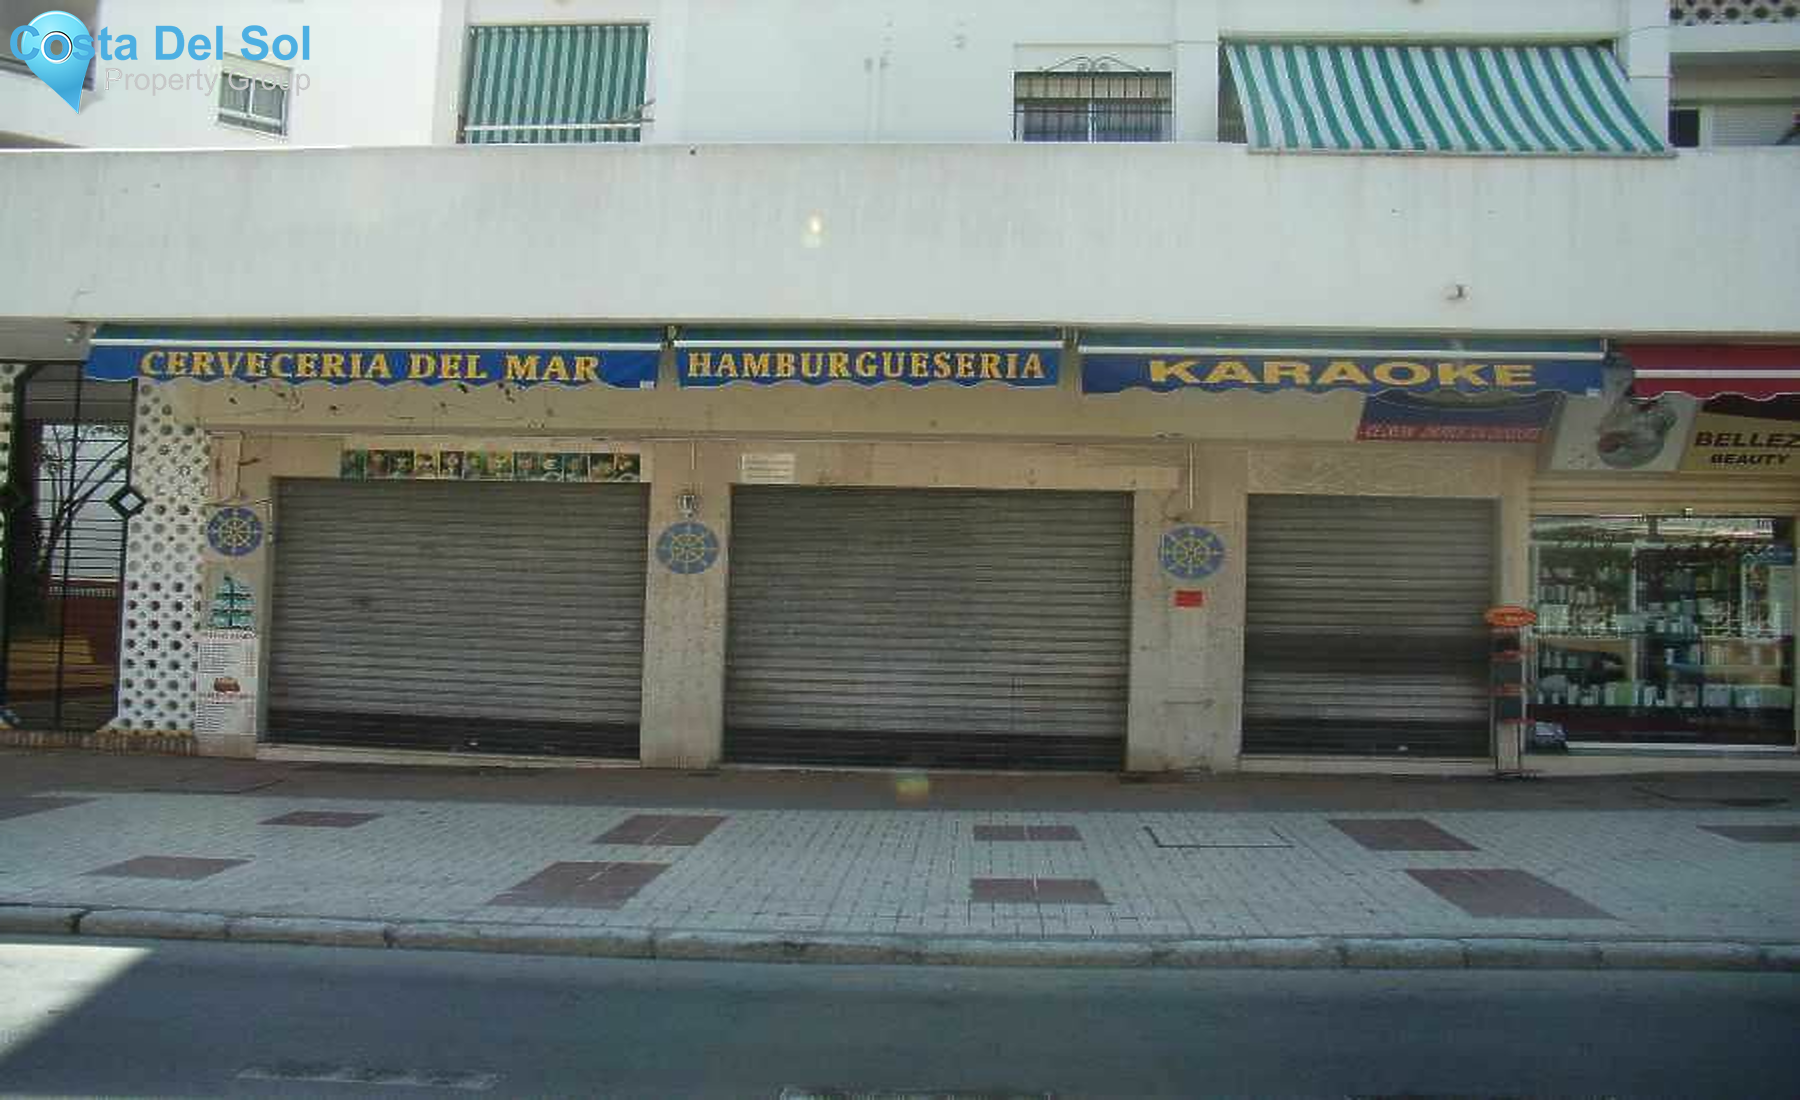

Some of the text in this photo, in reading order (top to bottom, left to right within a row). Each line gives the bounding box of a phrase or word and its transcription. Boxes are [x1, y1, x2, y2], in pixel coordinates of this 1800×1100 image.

[140, 351, 601, 382] CERVECERIA DEL MAR
[687, 352, 1046, 379] HAMBURGUESERIA
[1149, 360, 1537, 386] KARAOKE
[1711, 453, 1790, 465] BEAUTY
